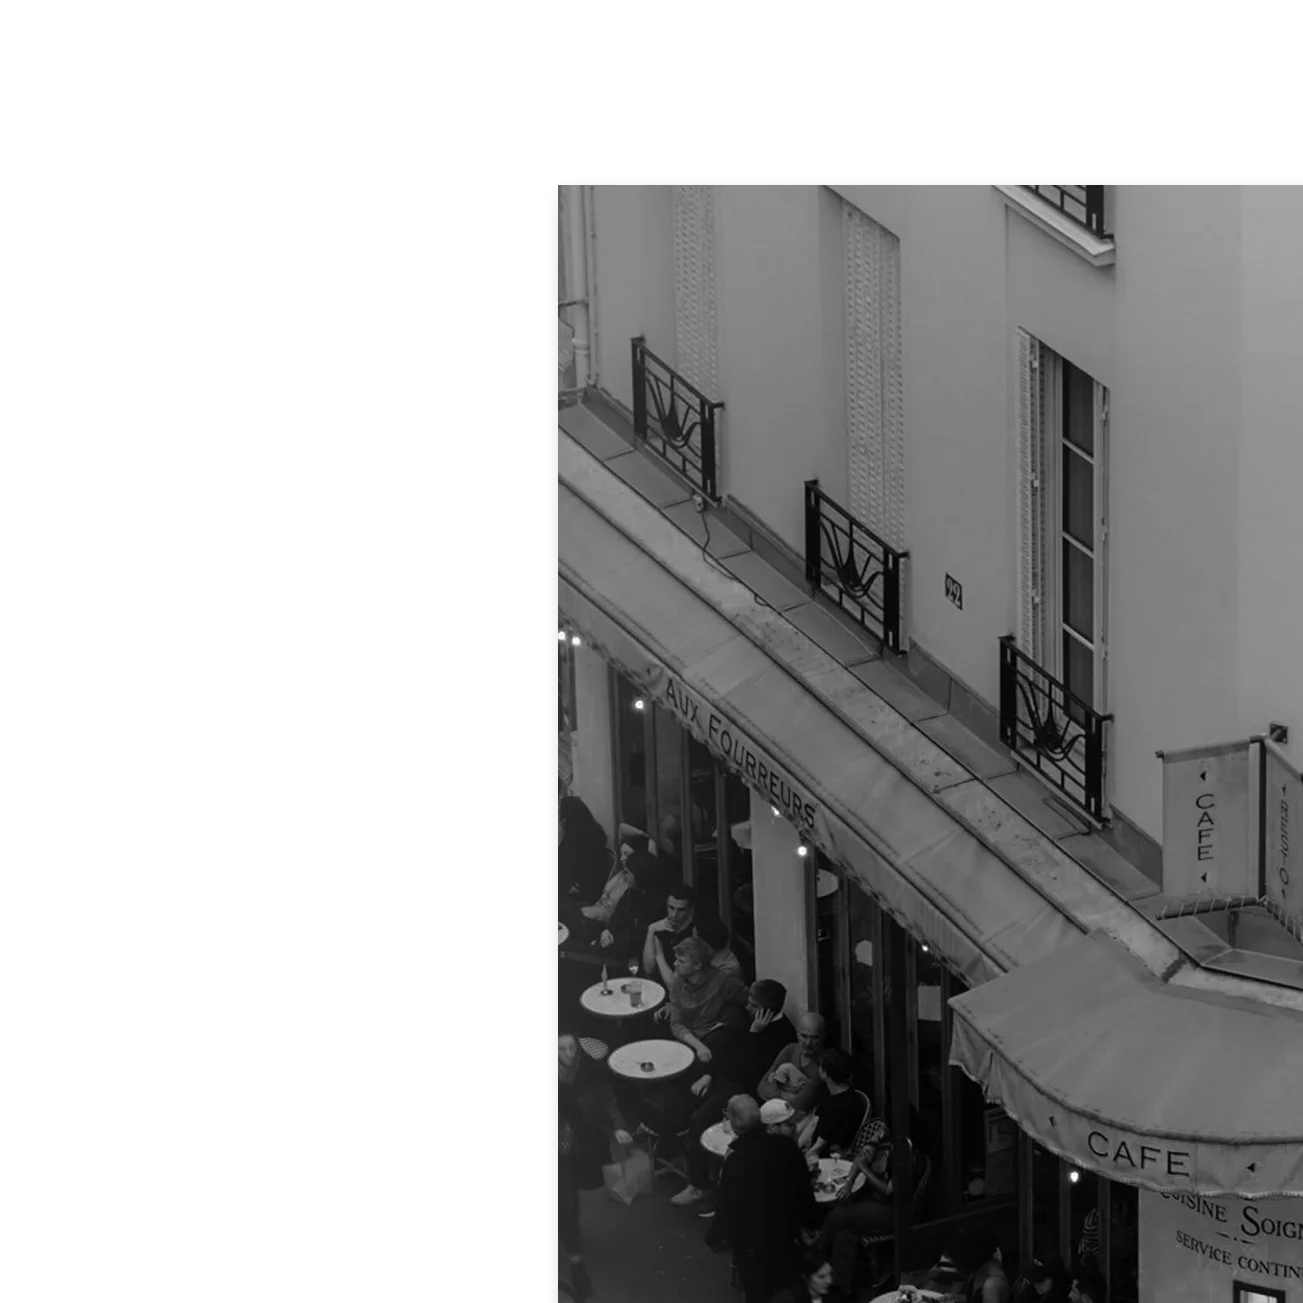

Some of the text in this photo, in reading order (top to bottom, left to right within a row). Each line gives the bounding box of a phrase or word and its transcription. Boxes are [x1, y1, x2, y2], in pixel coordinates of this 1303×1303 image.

[946, 577, 961, 607] 22
[666, 678, 816, 829] AUX FOURREURS
[1195, 793, 1215, 861] CAFE
[1087, 1131, 1190, 1177] CAFE
[1176, 1229, 1232, 1266] SERVICE
